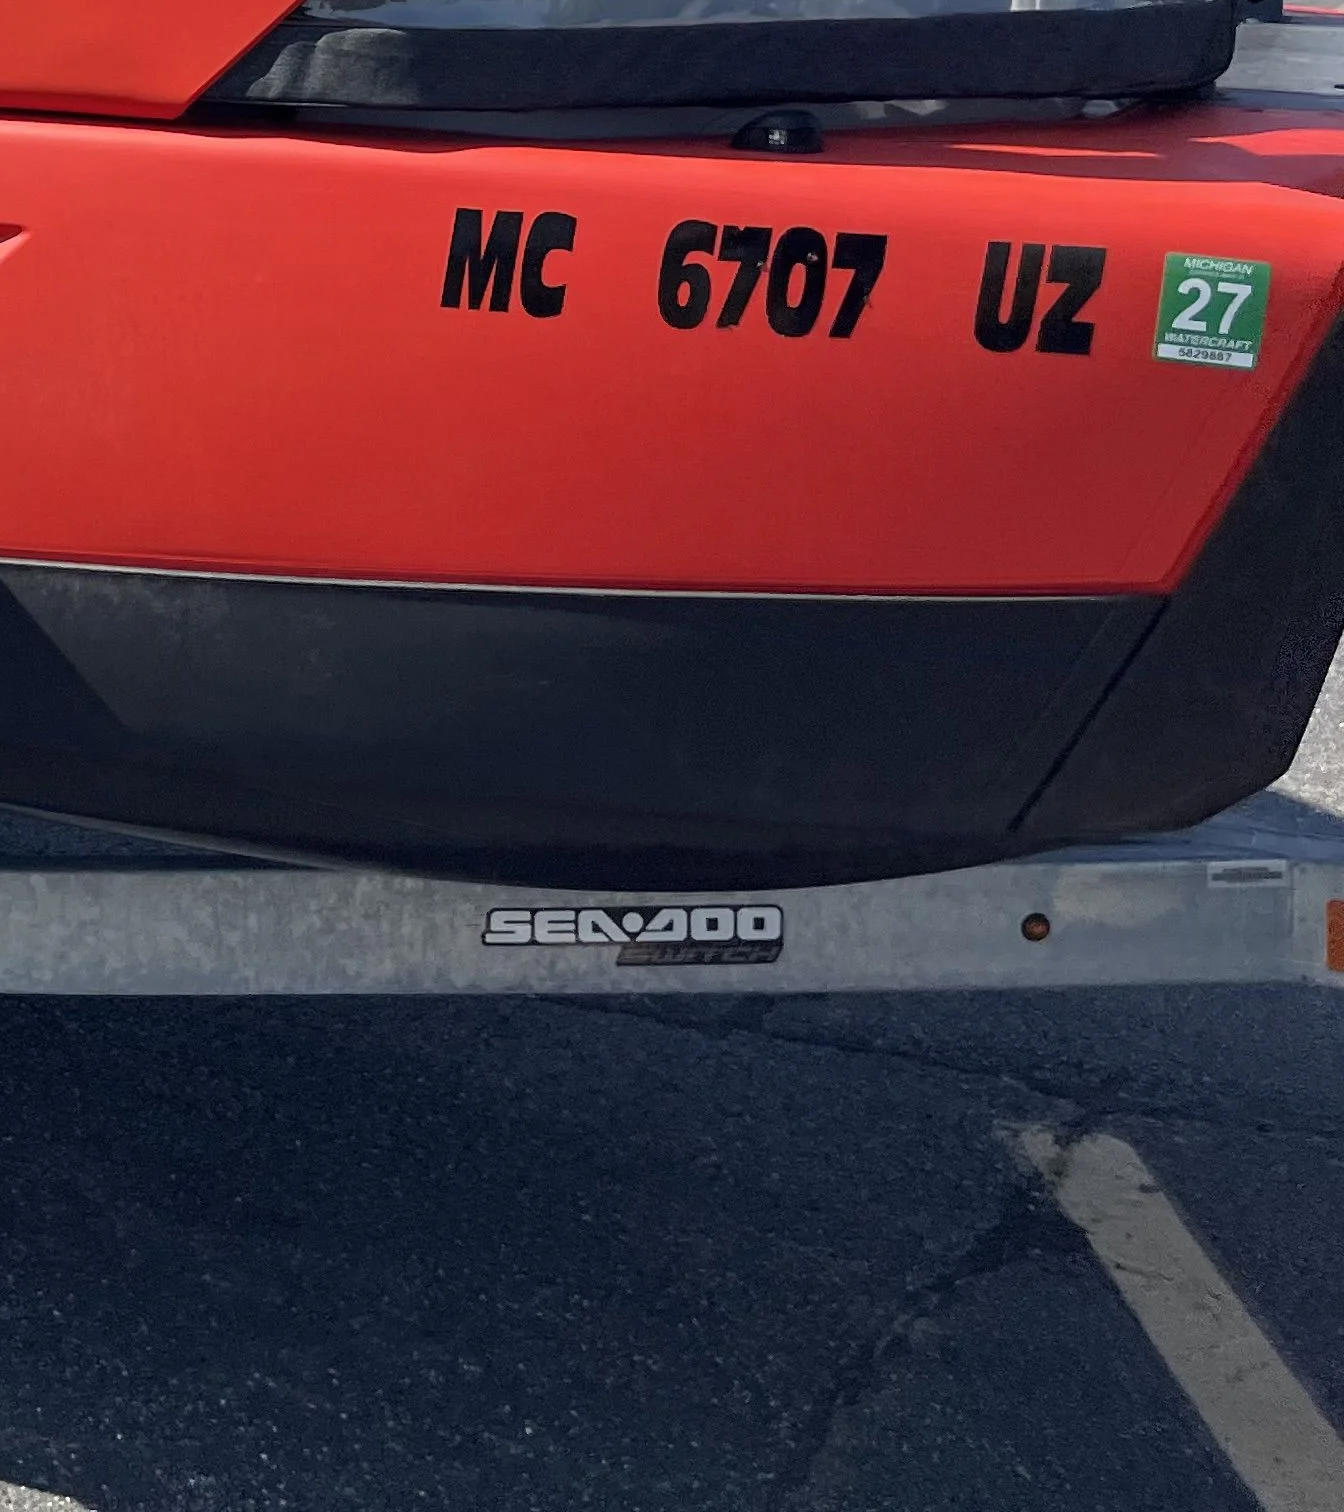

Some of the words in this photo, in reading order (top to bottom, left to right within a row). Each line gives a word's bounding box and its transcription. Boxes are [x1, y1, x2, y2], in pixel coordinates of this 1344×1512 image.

[440, 207, 577, 318] MC
[657, 219, 888, 338] 6707
[974, 241, 1107, 355] UZ
[1183, 257, 1254, 275] MICHIGAN
[1172, 277, 1252, 335] 27
[1164, 332, 1253, 350] WATERCRAFT
